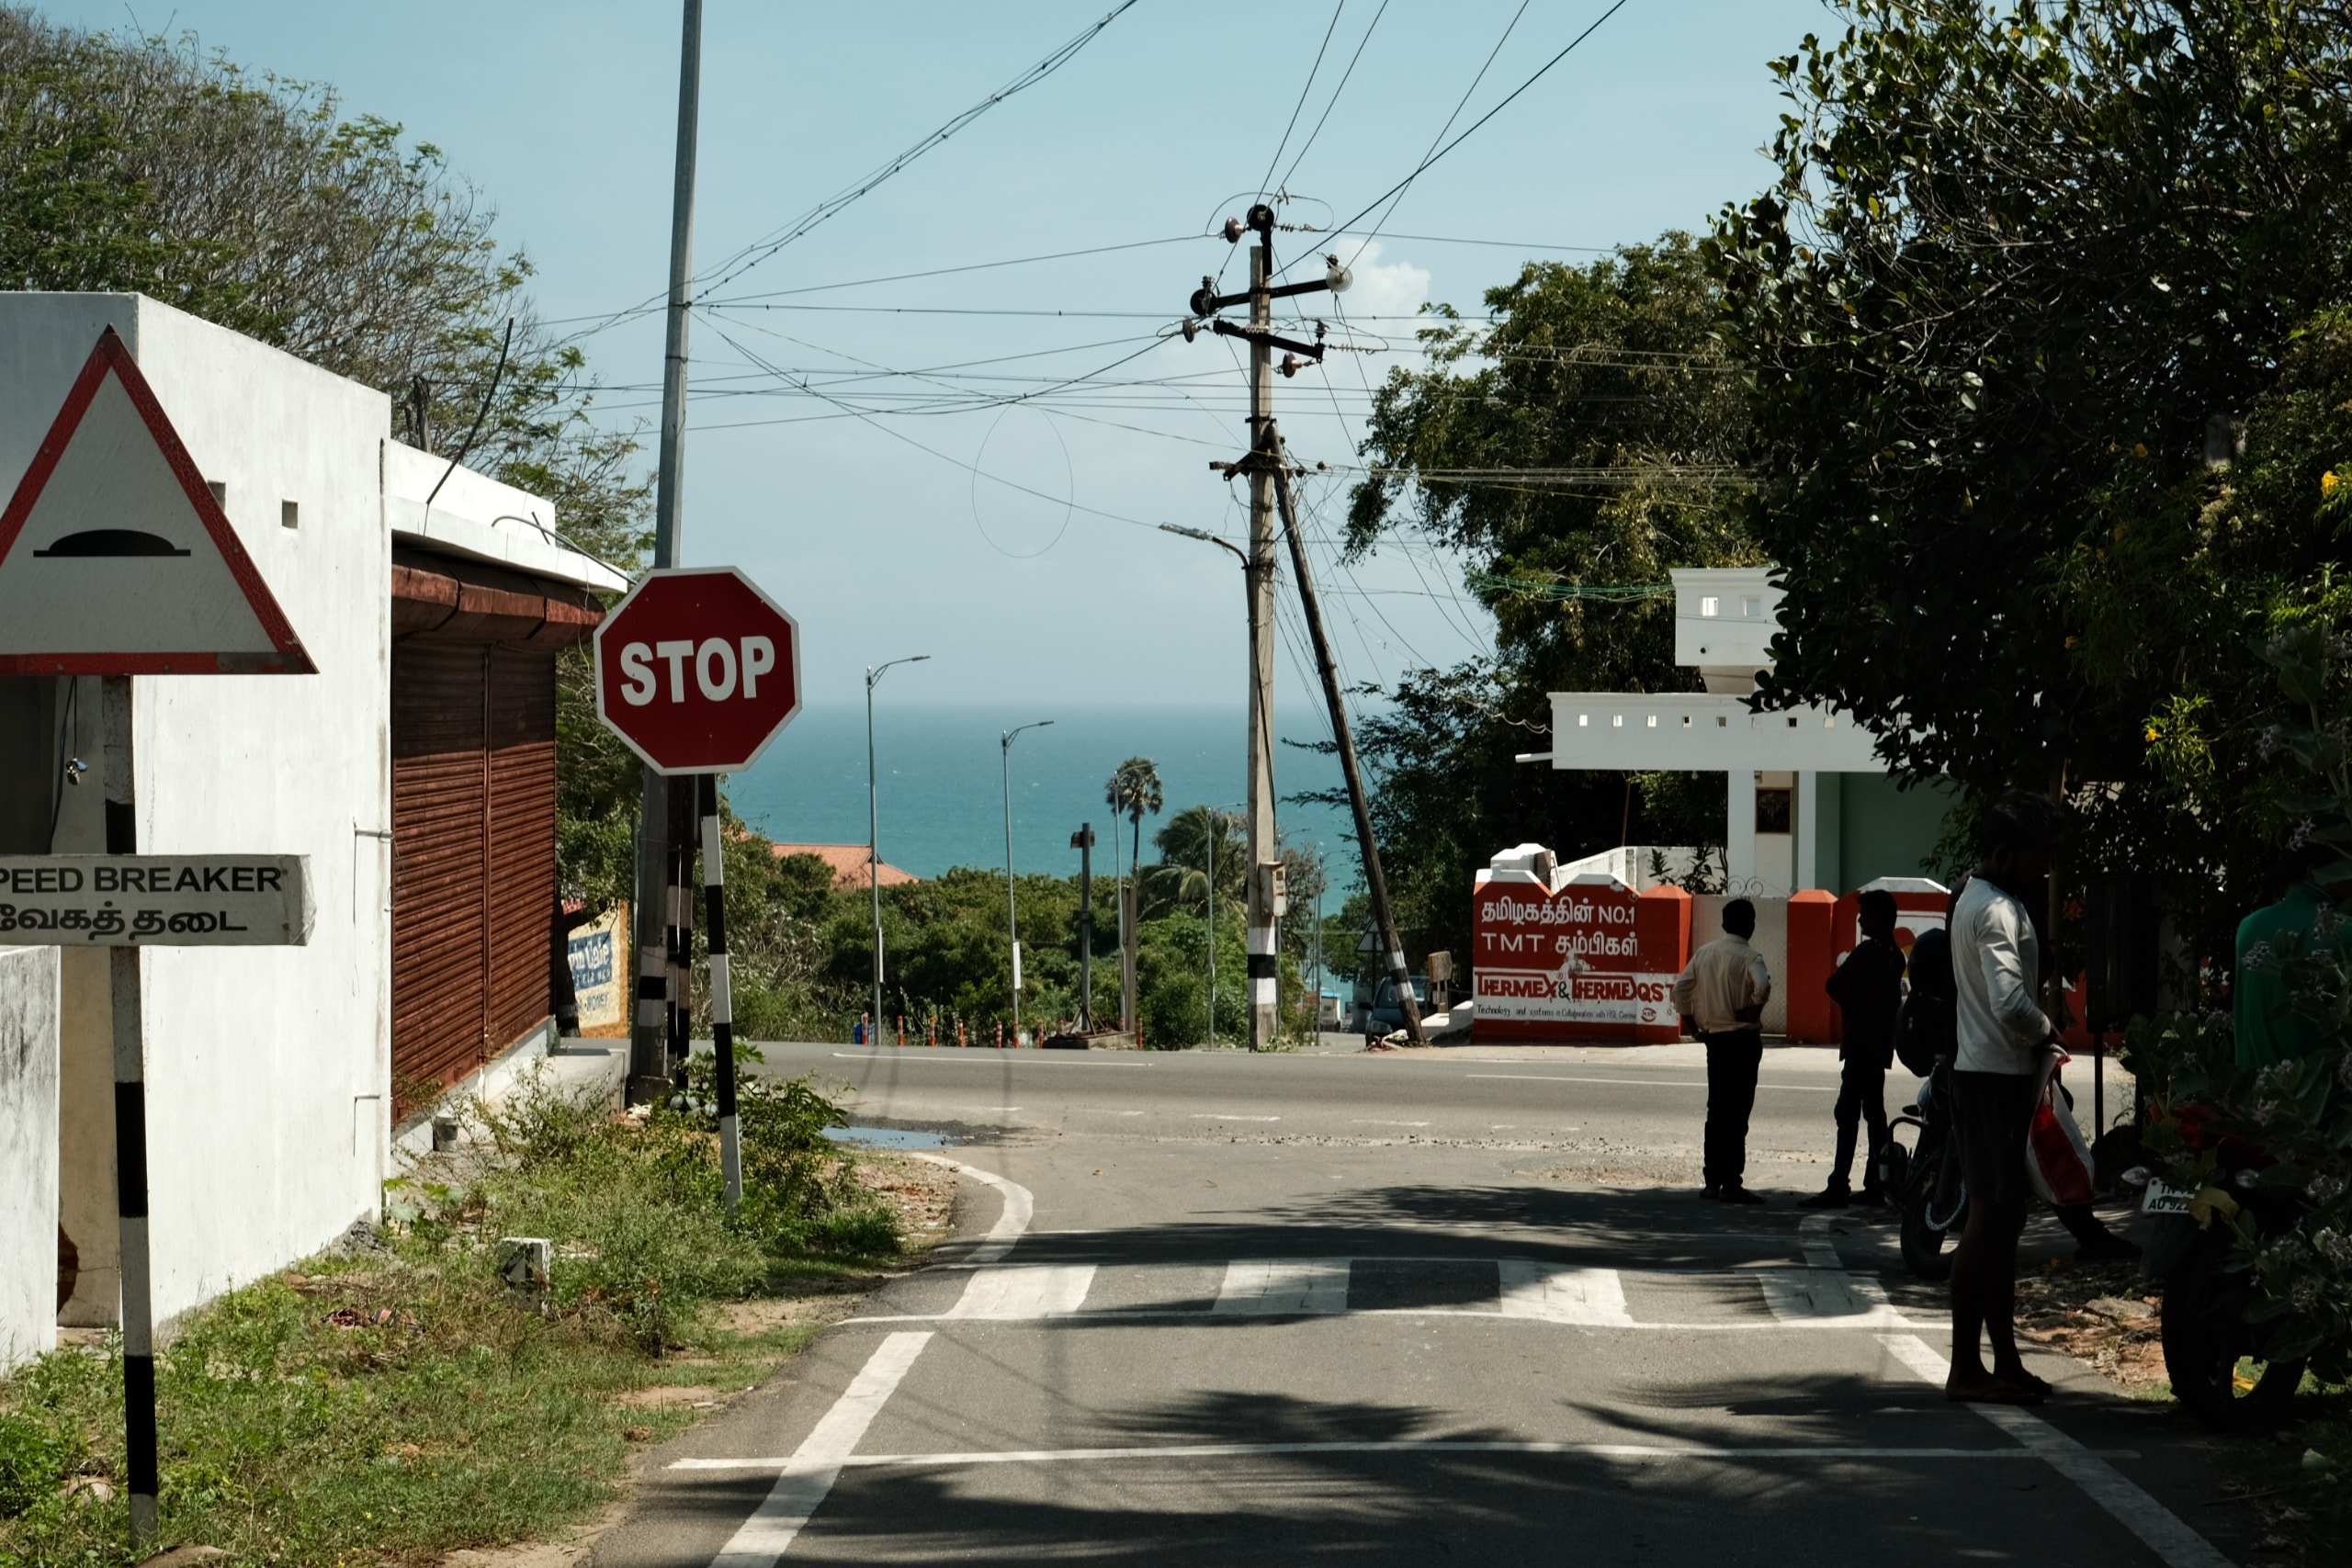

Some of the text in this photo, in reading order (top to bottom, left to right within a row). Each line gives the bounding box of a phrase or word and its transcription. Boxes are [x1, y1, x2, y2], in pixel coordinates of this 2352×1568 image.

[620, 635, 775, 706] STOP
[95, 866, 282, 892] BREAKER
[1481, 896, 1635, 926] தமிழகத்தின் NO.1
[1481, 932, 1545, 953] TMT
[1475, 971, 1559, 998] THERMEX
[1477, 1004, 1510, 1016] Technology
[1516, 1006, 1526, 1016] and
